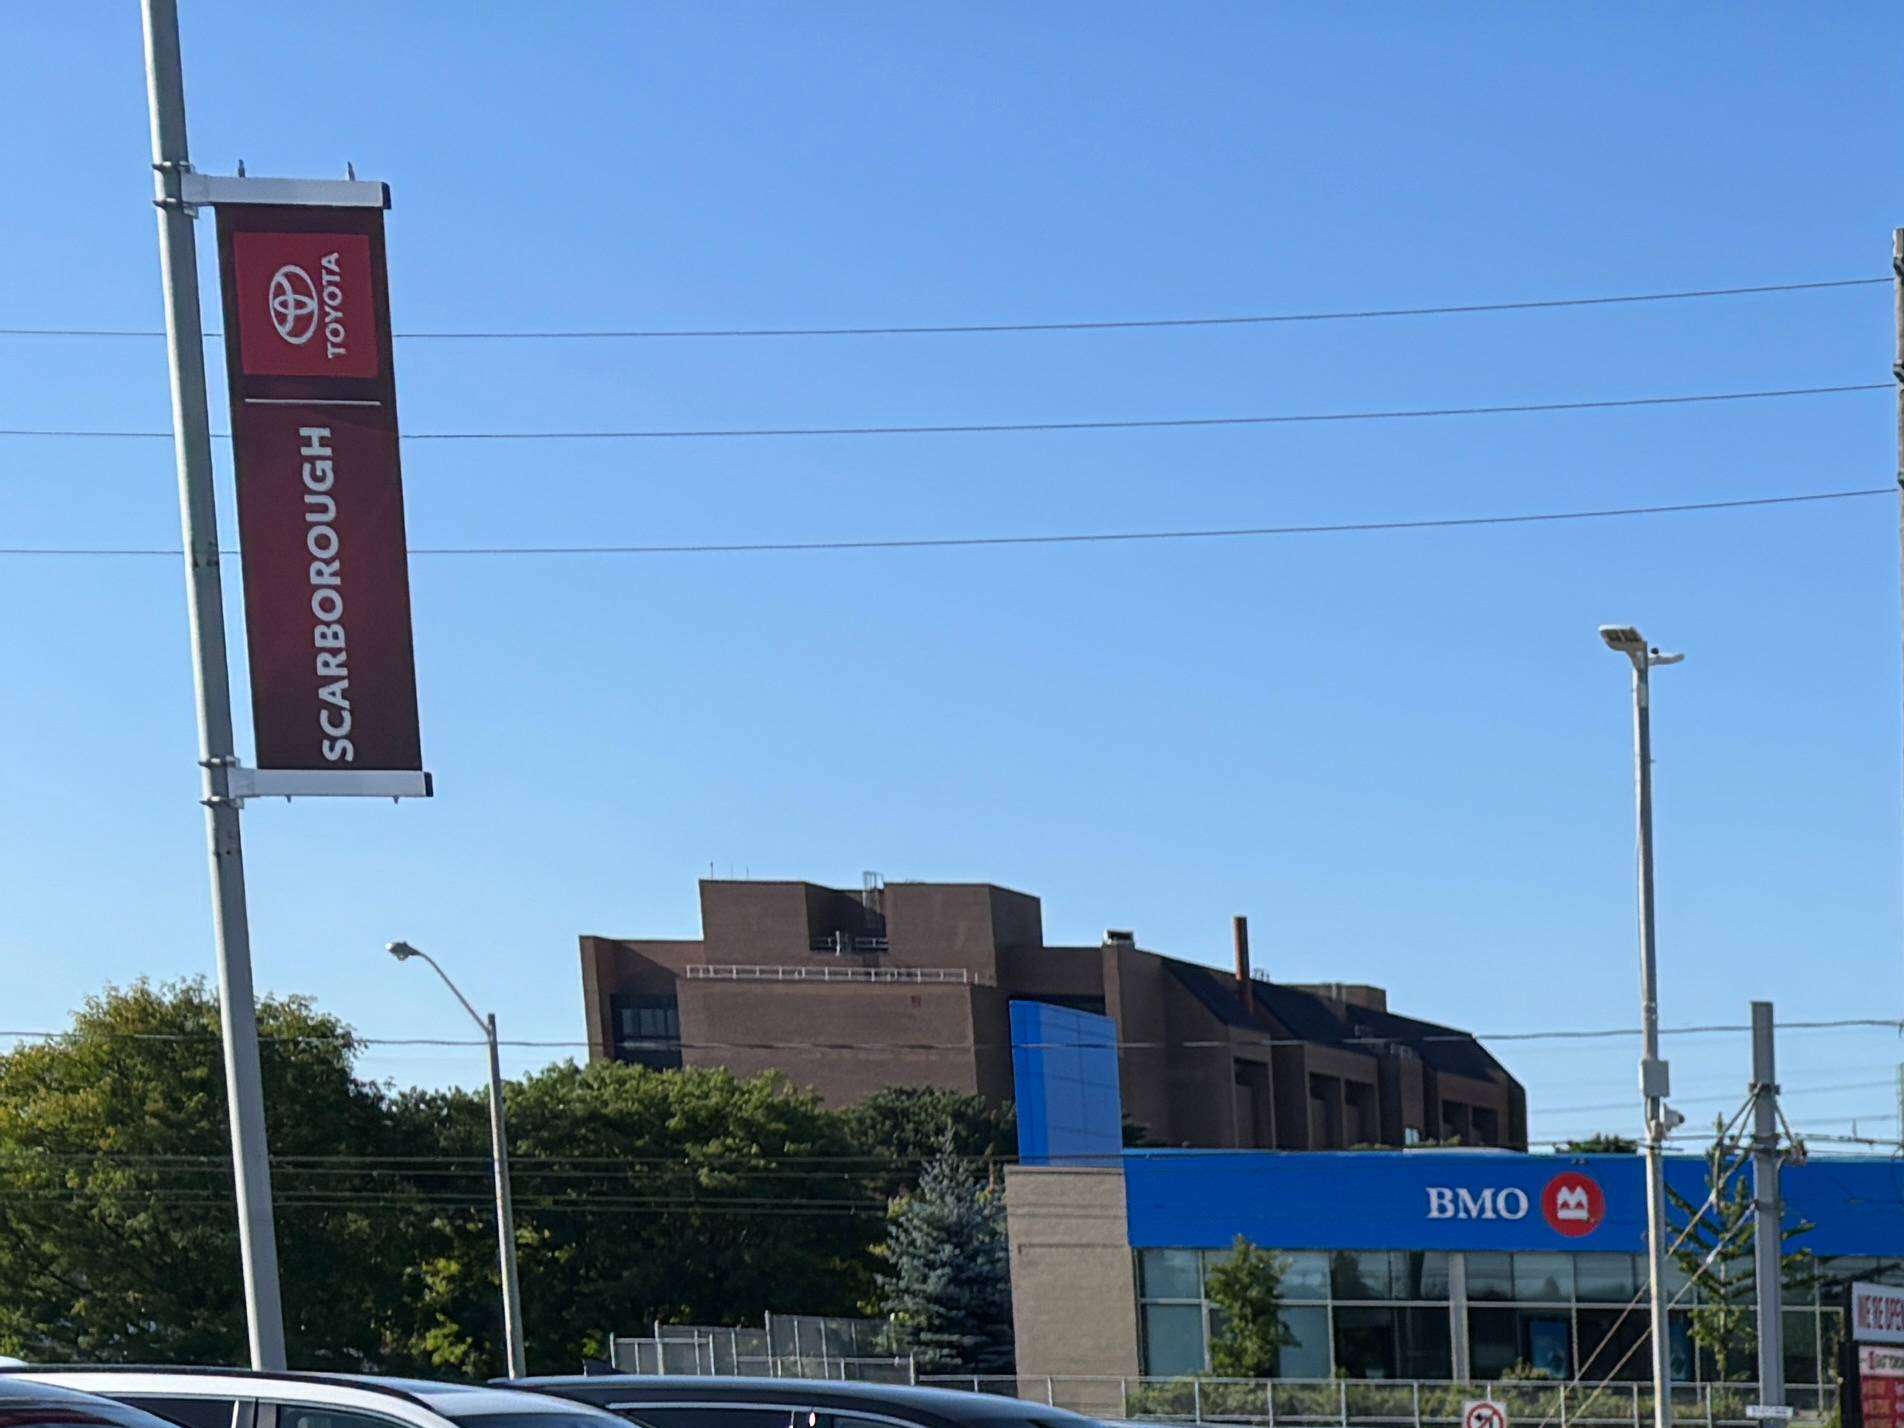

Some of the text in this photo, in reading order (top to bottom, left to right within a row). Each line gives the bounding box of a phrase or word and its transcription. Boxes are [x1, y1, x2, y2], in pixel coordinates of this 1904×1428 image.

[319, 252, 347, 359] TOYOTA
[298, 426, 355, 763] SCARBOROUGH
[1425, 1186, 1530, 1221] BMO
